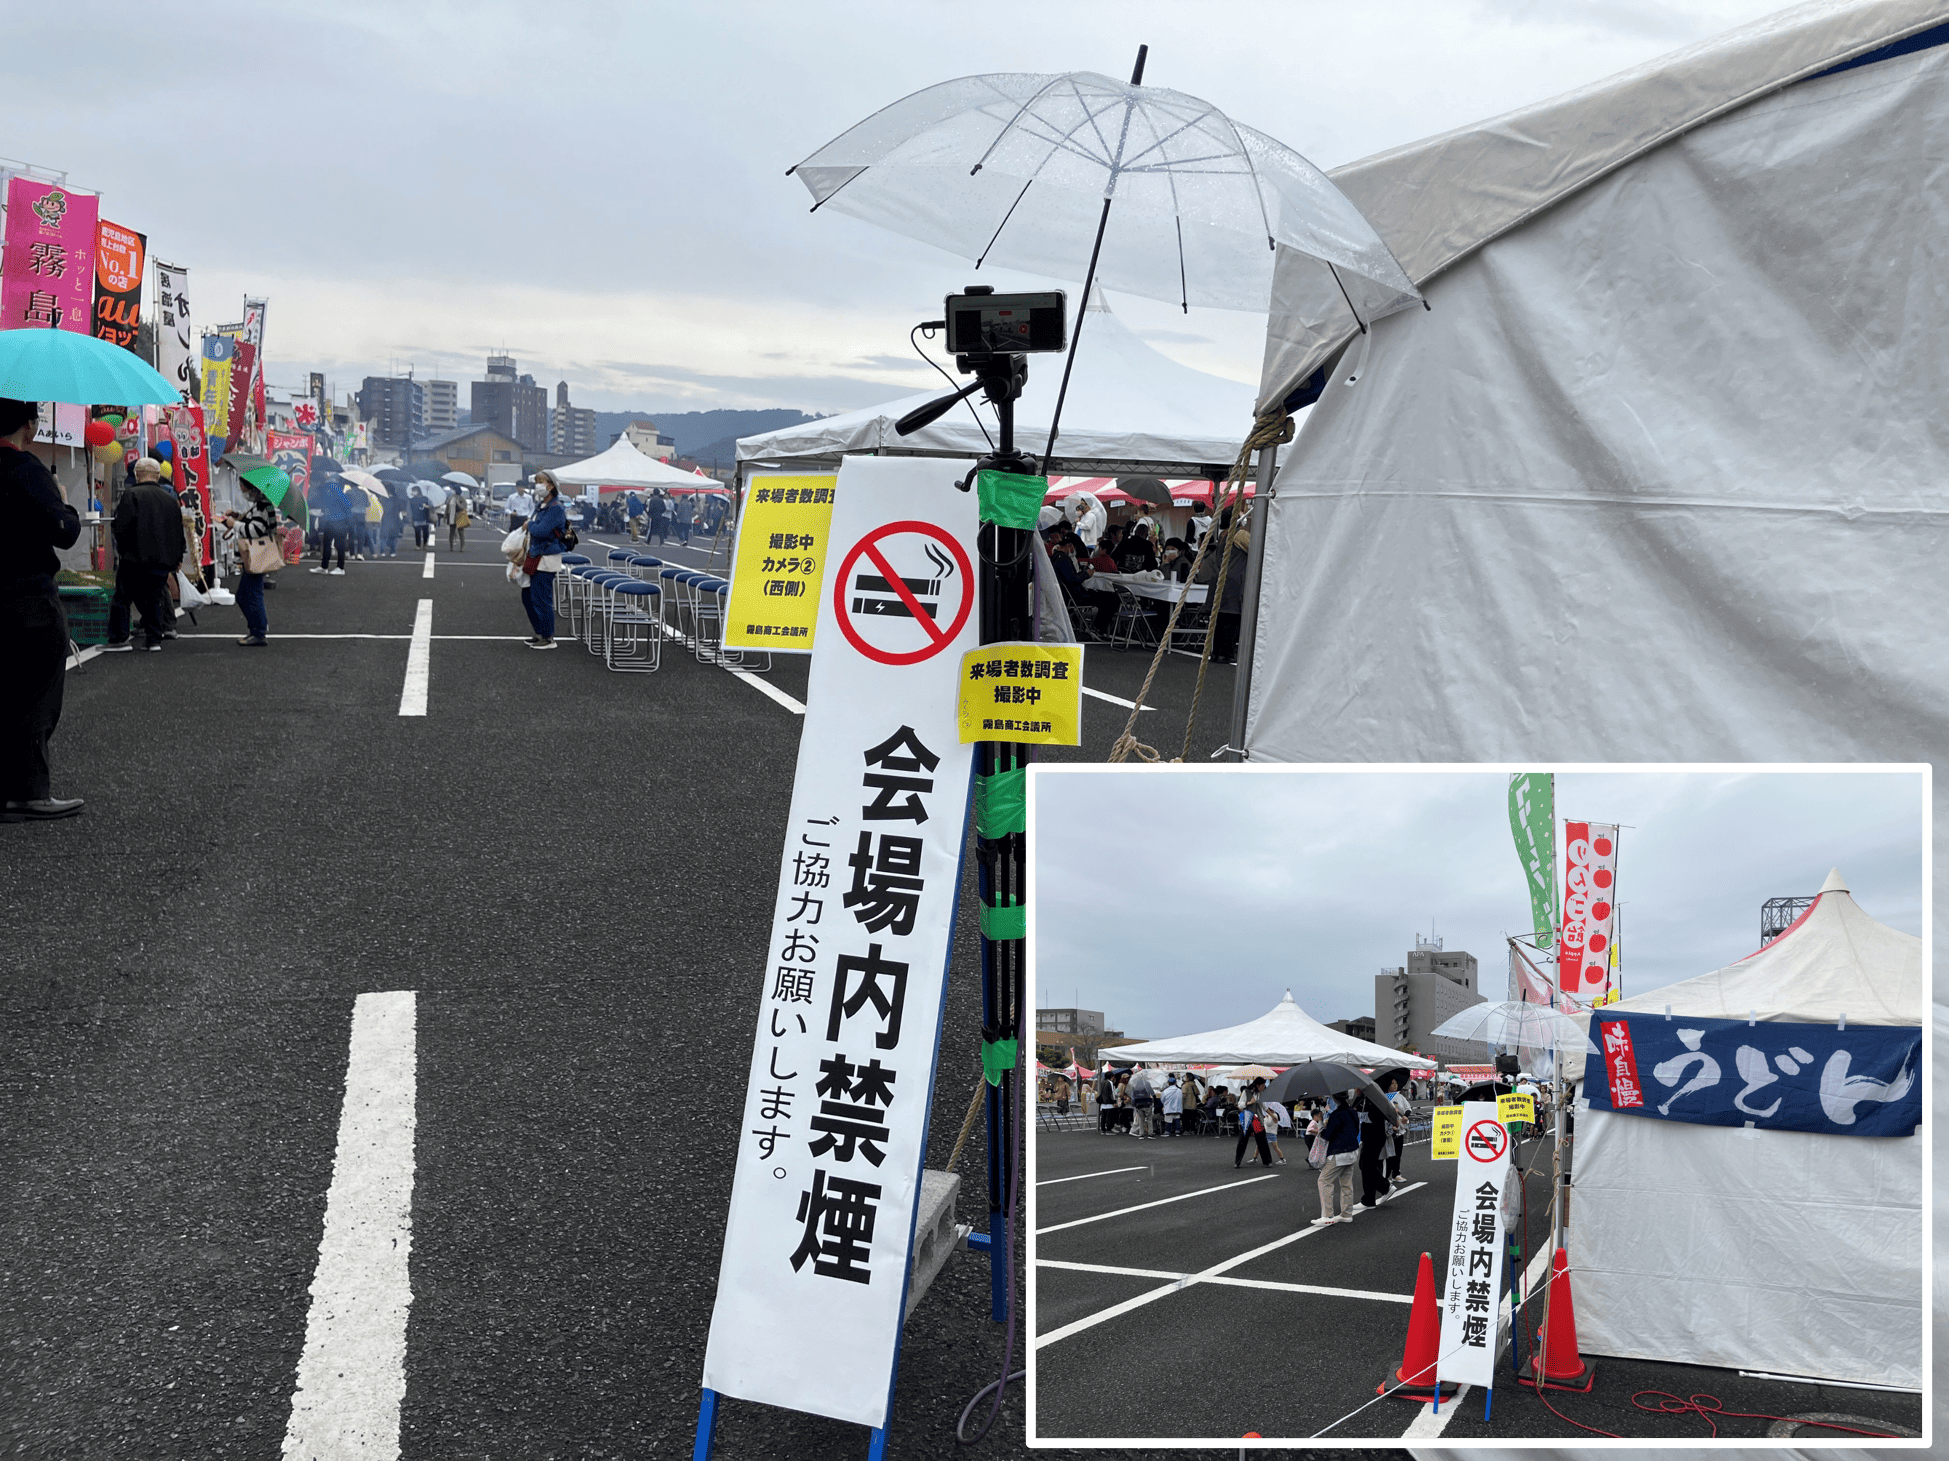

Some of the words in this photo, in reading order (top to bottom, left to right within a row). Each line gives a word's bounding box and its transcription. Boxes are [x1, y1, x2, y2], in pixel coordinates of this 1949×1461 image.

[24, 241, 68, 326] 霧島
[761, 556, 816, 574] カメラ②
[768, 533, 814, 551] 撮影中
[746, 624, 808, 638] 霧島商工会議所
[969, 659, 1069, 680] 来場者数調査
[982, 718, 1052, 733] 霧島商工会議所
[993, 685, 1042, 706] 撮影中
[751, 816, 840, 1180] ご協力お願いします。
[790, 725, 940, 1284] 会場内禁煙
[1605, 1022, 1643, 1107] 味自慢
[1653, 1028, 1915, 1125] うどん
[1448, 1209, 1470, 1320] ご協力お願いします。
[1461, 1181, 1499, 1348] 会場内禁煙
